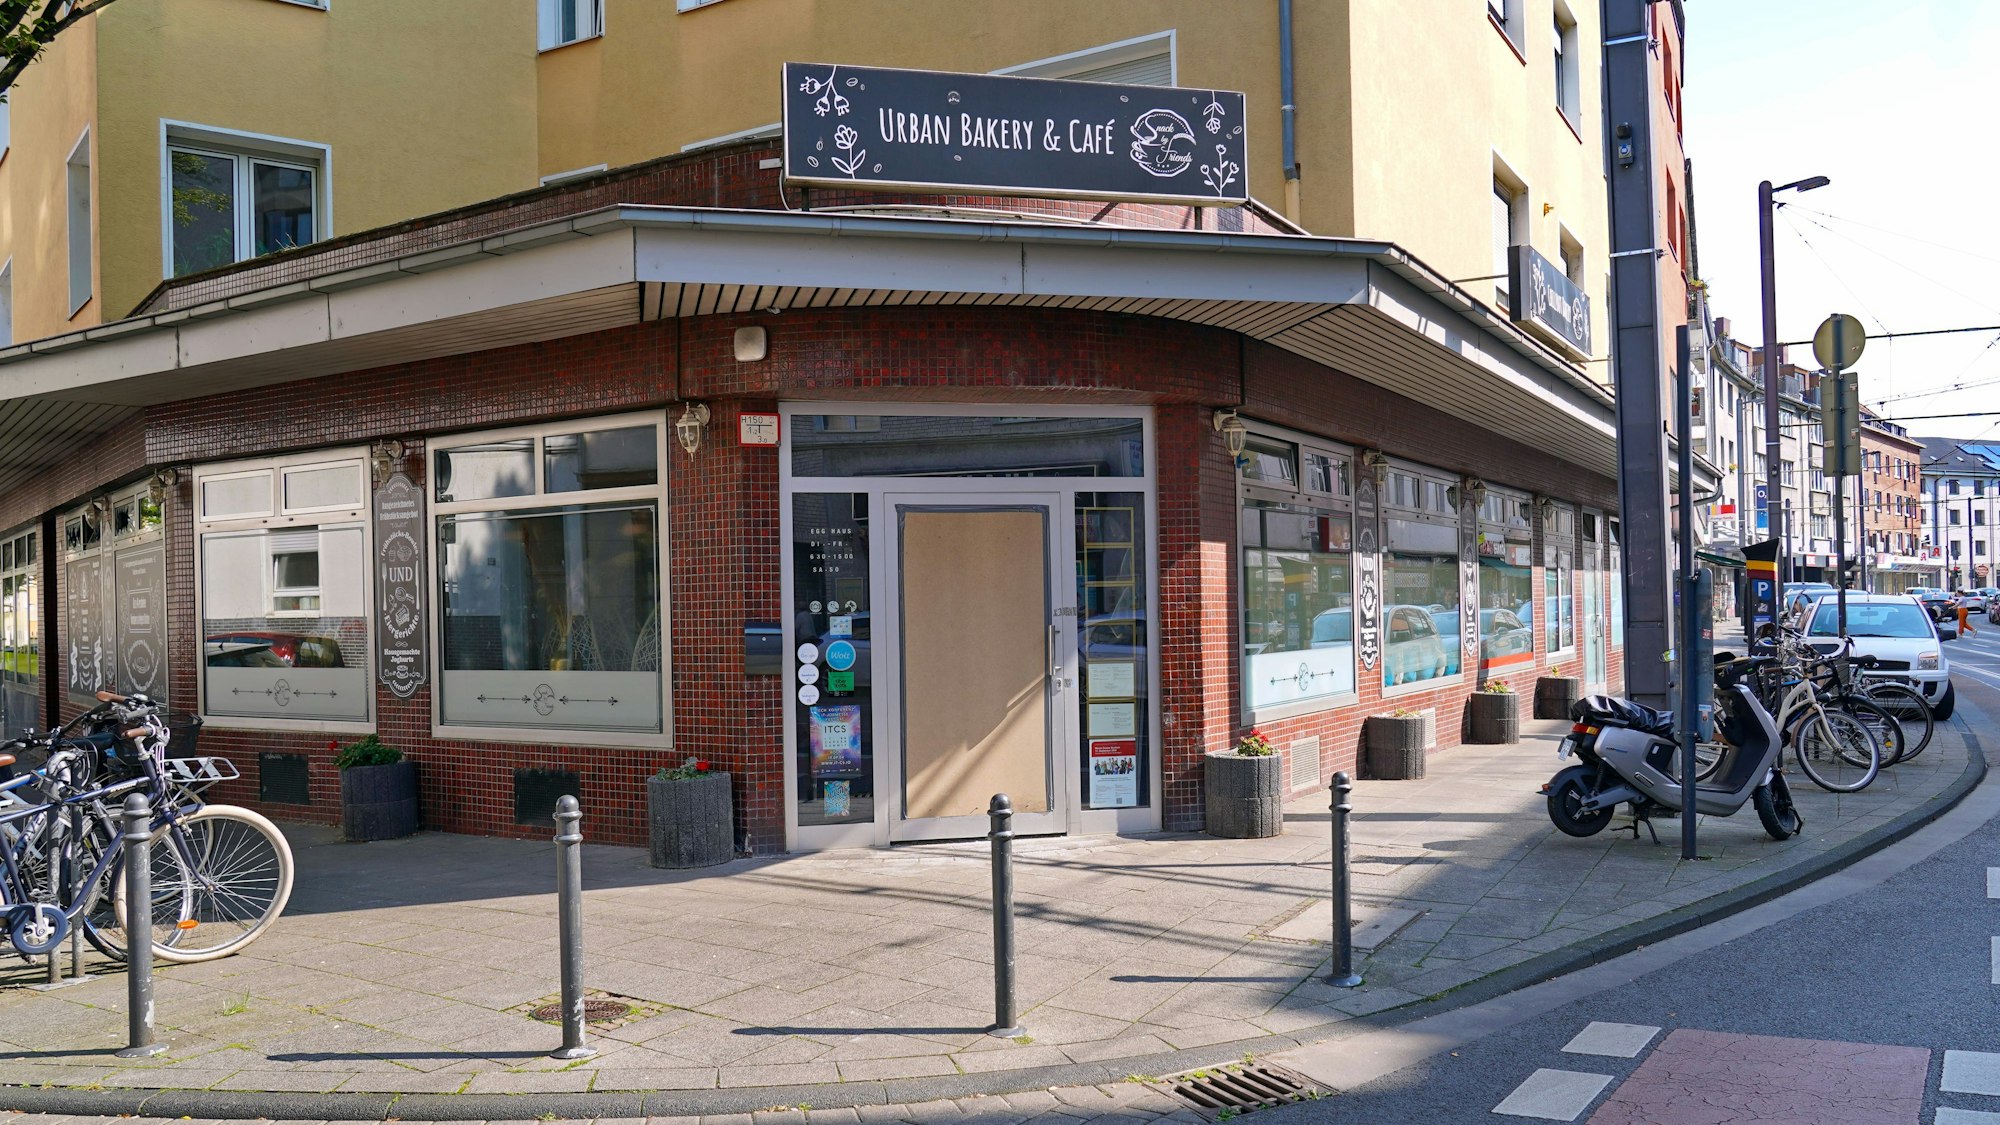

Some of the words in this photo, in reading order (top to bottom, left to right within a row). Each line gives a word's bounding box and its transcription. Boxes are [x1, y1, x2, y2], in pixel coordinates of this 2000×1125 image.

[1144, 114, 1175, 140] Snack
[1043, 118, 1061, 151] &
[1160, 135, 1169, 145] by
[741, 415, 763, 424] H150
[389, 566, 413, 583] UND
[1757, 581, 1769, 597] P
[831, 651, 850, 660] Wolt
[824, 724, 847, 733] ITCS
